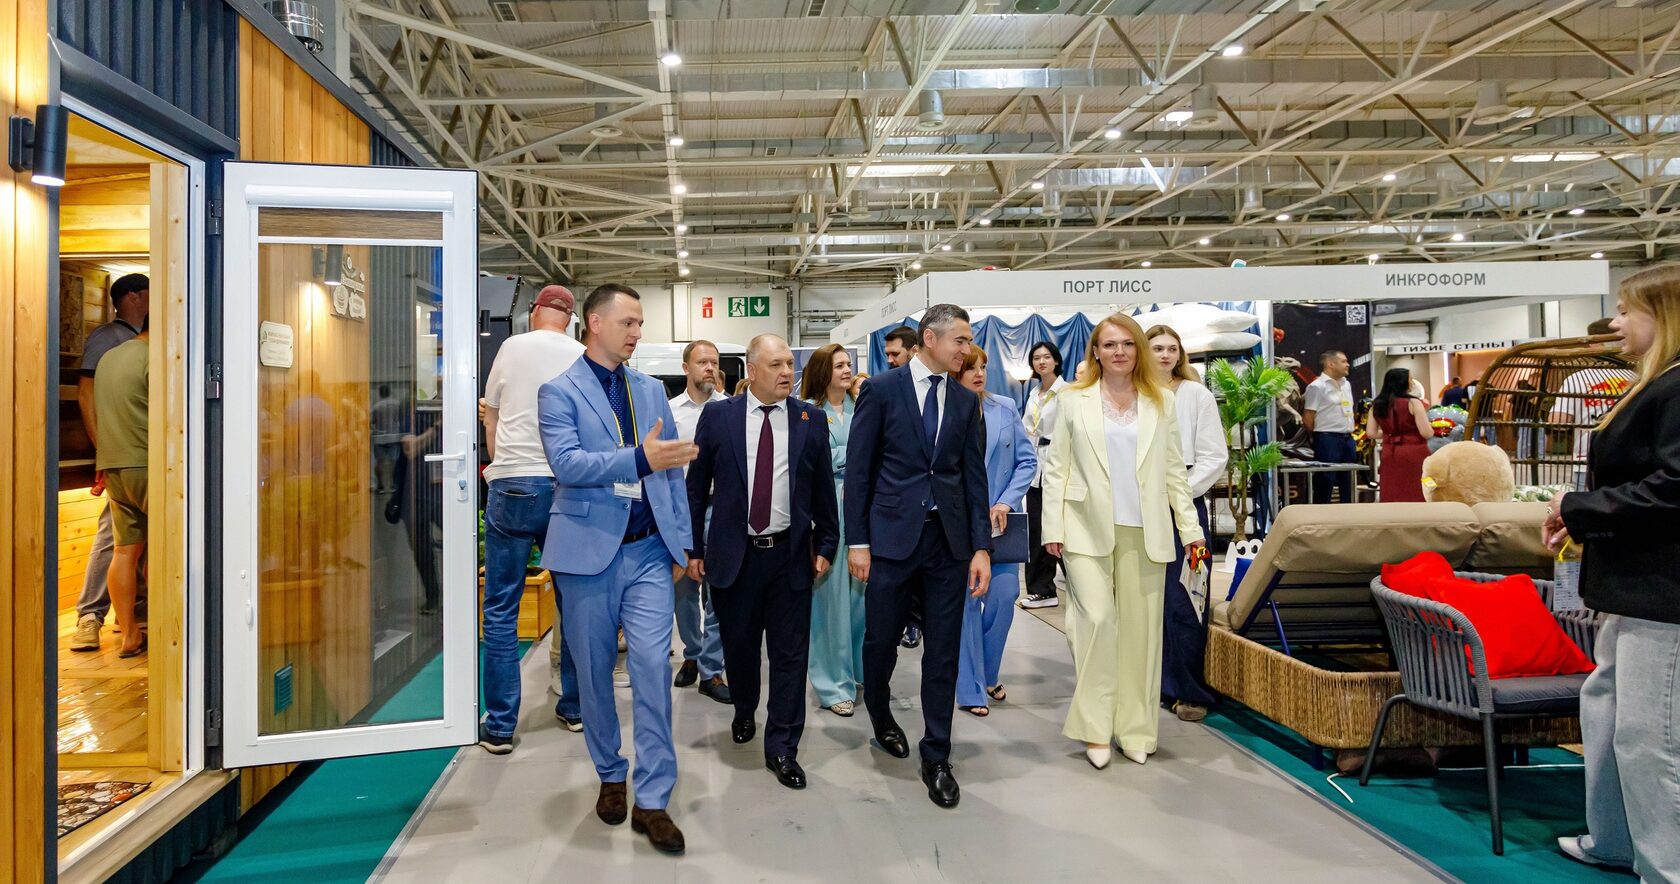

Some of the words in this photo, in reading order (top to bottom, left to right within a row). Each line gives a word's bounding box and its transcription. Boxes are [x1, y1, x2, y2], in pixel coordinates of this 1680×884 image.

[1385, 272, 1486, 286] ИНКРОФОРМ
[1063, 280, 1104, 293] ПОРТ
[1109, 280, 1152, 293] ЛИСС
[1403, 344, 1447, 353] ТИХИЕ
[1454, 341, 1505, 350] СТЕНЫ
